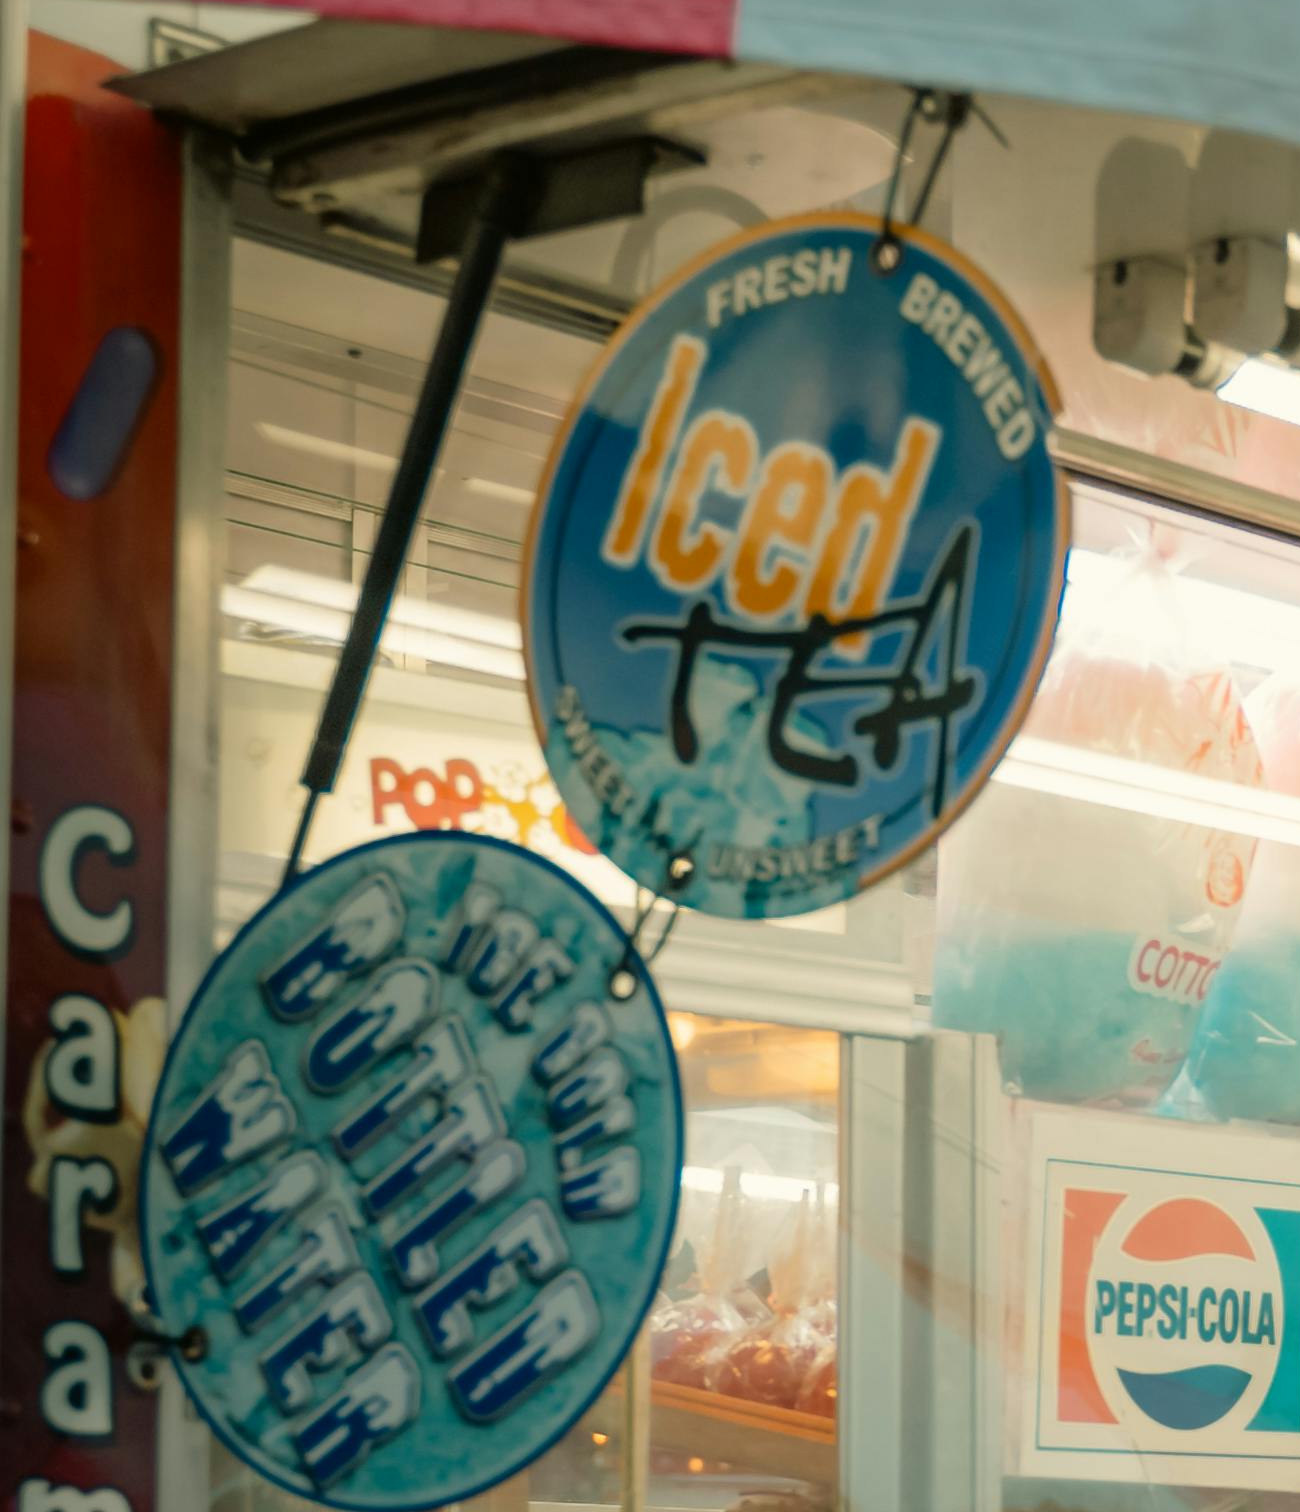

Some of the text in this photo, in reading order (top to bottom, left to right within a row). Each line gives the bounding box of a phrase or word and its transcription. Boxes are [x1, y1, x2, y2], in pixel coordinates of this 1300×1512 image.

[603, 335, 942, 658] Iced
[705, 247, 1035, 462] FRESH BREWED
[371, 756, 483, 831] POP
[554, 685, 634, 814] SWEET
[706, 813, 886, 882] UNSWEET
[620, 520, 982, 822] TEA
[260, 871, 602, 1424] BOTTLED
[442, 883, 642, 1222] ICE COLD
[160, 1039, 422, 1487] WATER
[1094, 1278, 1276, 1346] PEPSI-COLA
